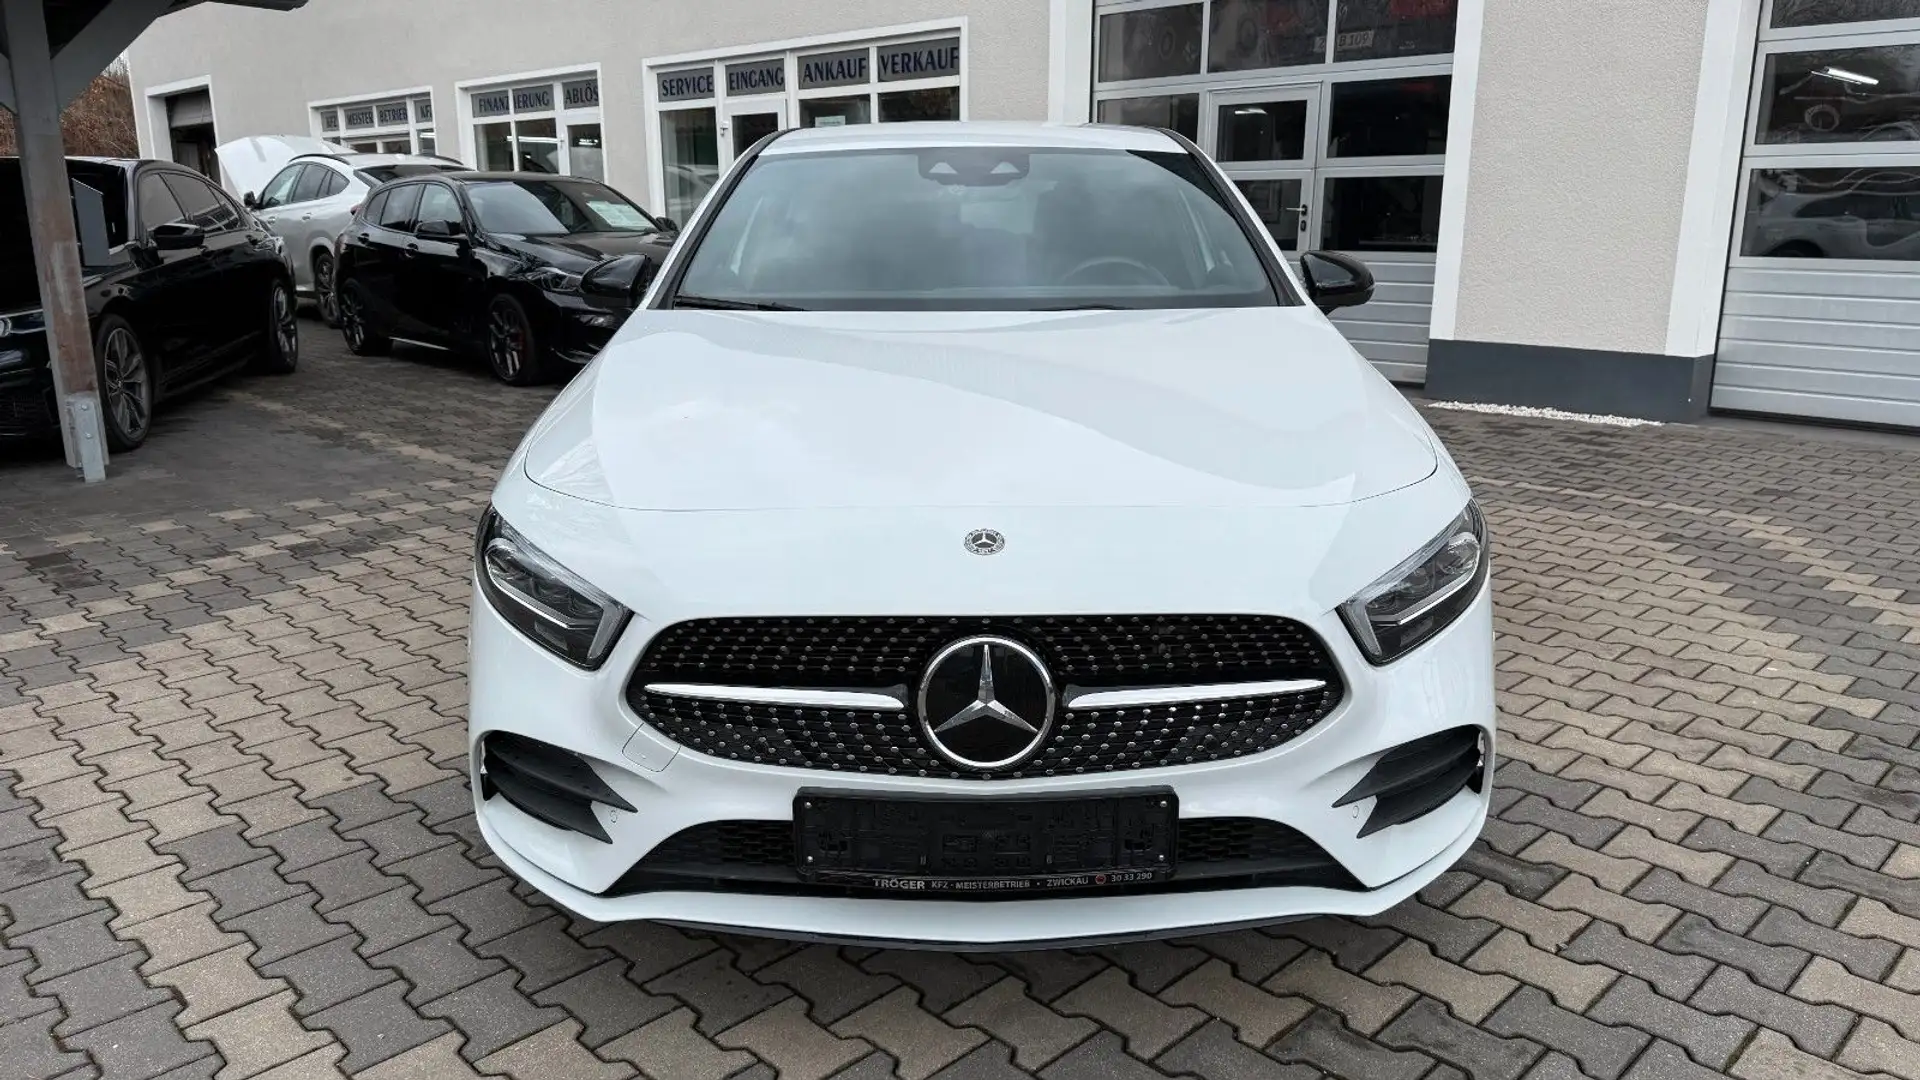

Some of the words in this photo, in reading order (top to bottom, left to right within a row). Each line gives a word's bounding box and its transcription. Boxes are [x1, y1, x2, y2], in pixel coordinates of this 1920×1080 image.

[802, 57, 866, 83] ANKAUF
[879, 47, 959, 74] VERKAUF
[662, 75, 714, 97] SERVICE
[729, 67, 784, 90] EINGANG
[479, 91, 550, 113] FINANZIERUNG
[347, 109, 374, 125] MEISTER
[380, 107, 408, 122] BETRIEB
[873, 878, 925, 890] TRÖGER
[931, 880, 949, 889] KFZ
[955, 880, 1030, 890] MEISTERBETRIEB
[1046, 876, 1089, 888] ZWICKAU
[1124, 873, 1134, 881] 33
[1137, 872, 1152, 880] 290
